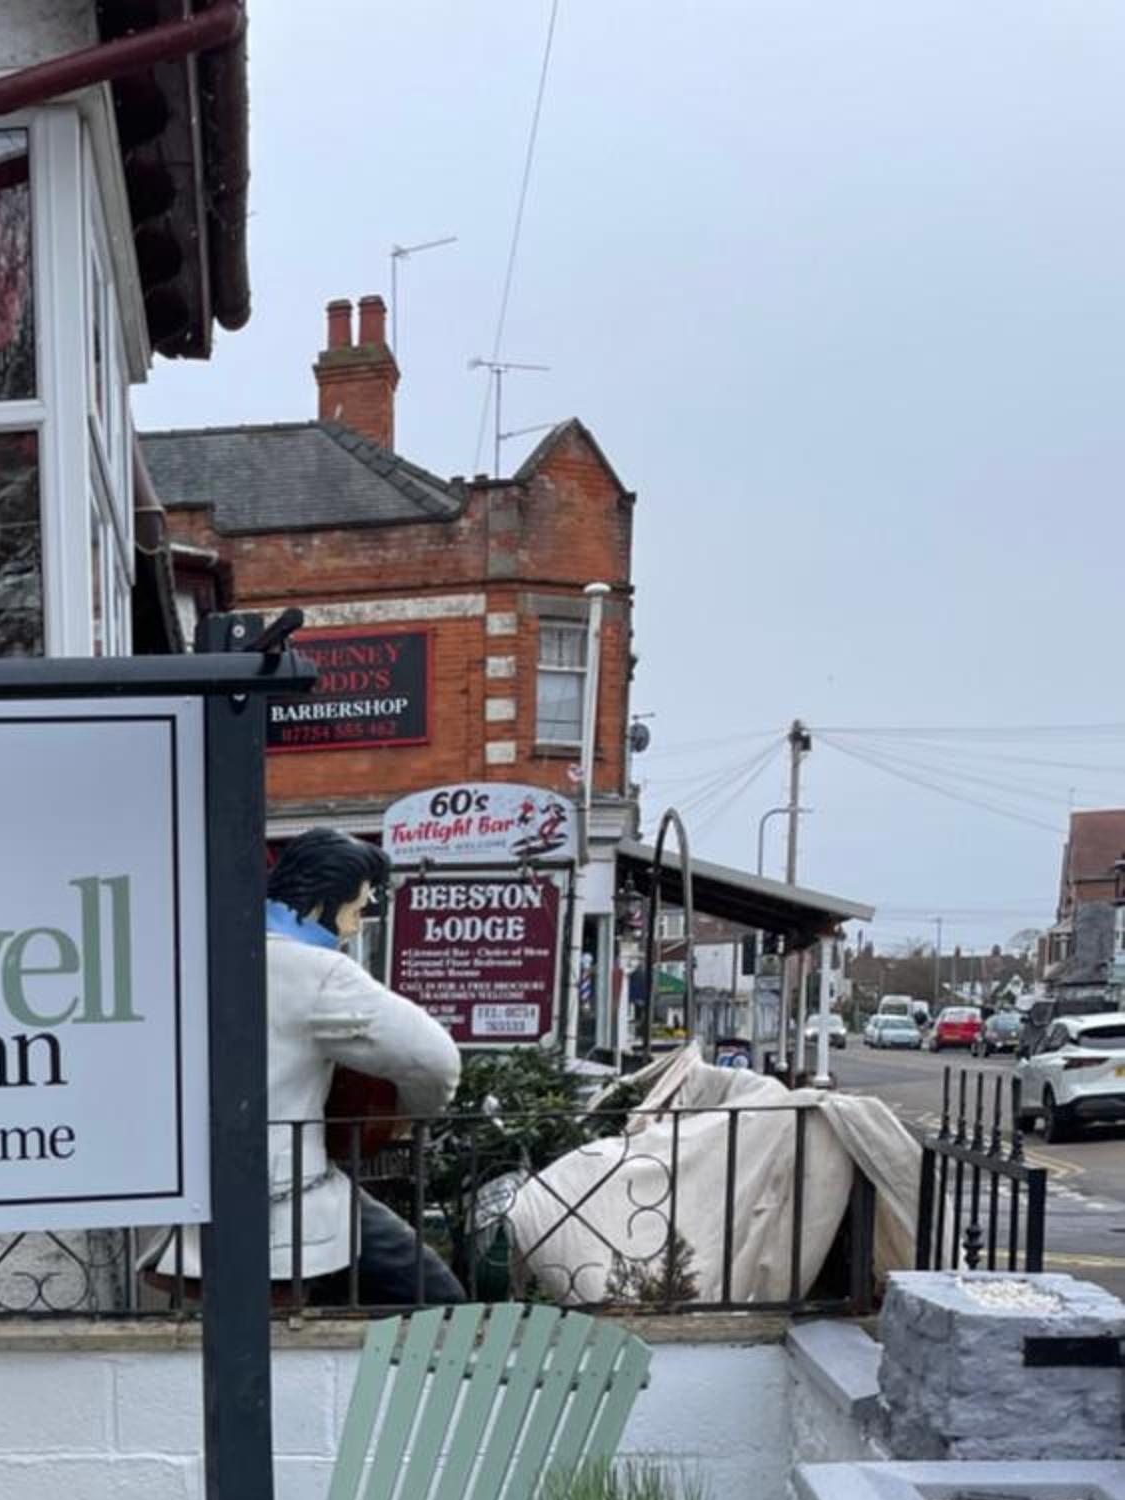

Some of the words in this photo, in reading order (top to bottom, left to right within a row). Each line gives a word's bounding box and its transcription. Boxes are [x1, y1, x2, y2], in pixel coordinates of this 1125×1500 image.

[295, 641, 402, 668] EENEY
[318, 670, 391, 692] ODD'S
[271, 697, 408, 722] BARBERSHOP
[430, 789, 490, 817] 60's
[389, 817, 473, 845] Twilight
[477, 815, 513, 834] Bar
[410, 884, 544, 910] BEESTON
[425, 916, 526, 942] LODGE
